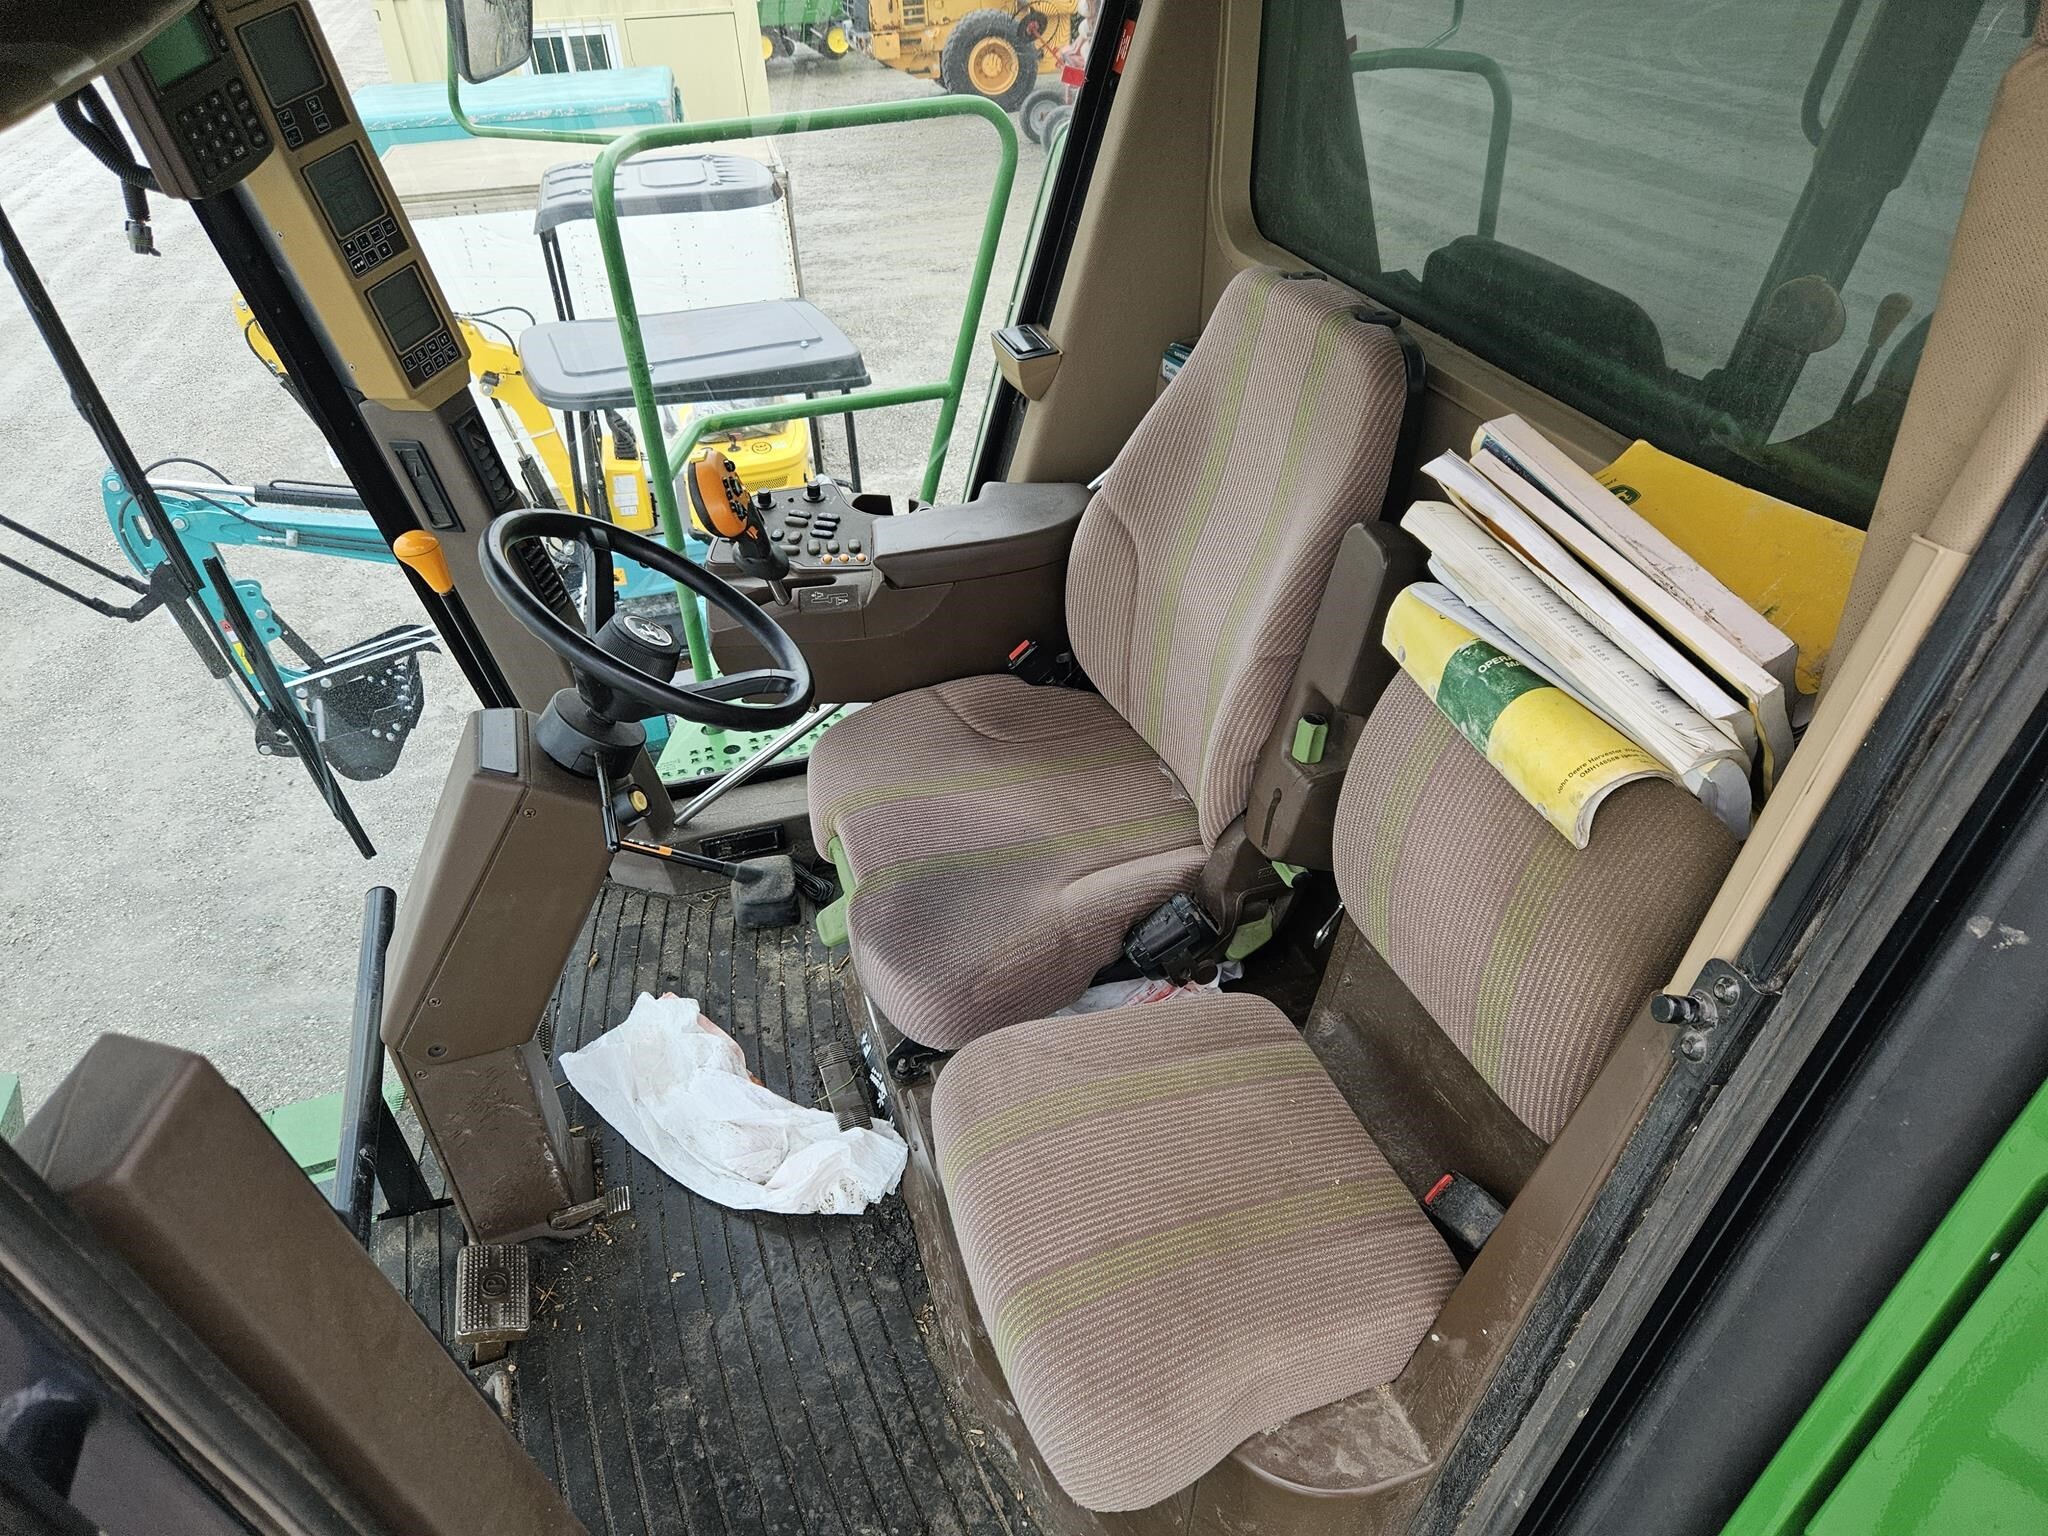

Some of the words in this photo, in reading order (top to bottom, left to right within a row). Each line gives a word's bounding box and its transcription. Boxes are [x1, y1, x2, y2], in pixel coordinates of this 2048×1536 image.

[1557, 778, 1569, 794] John
[1567, 763, 1588, 778] Deere
[1587, 748, 1622, 764] Harvester
